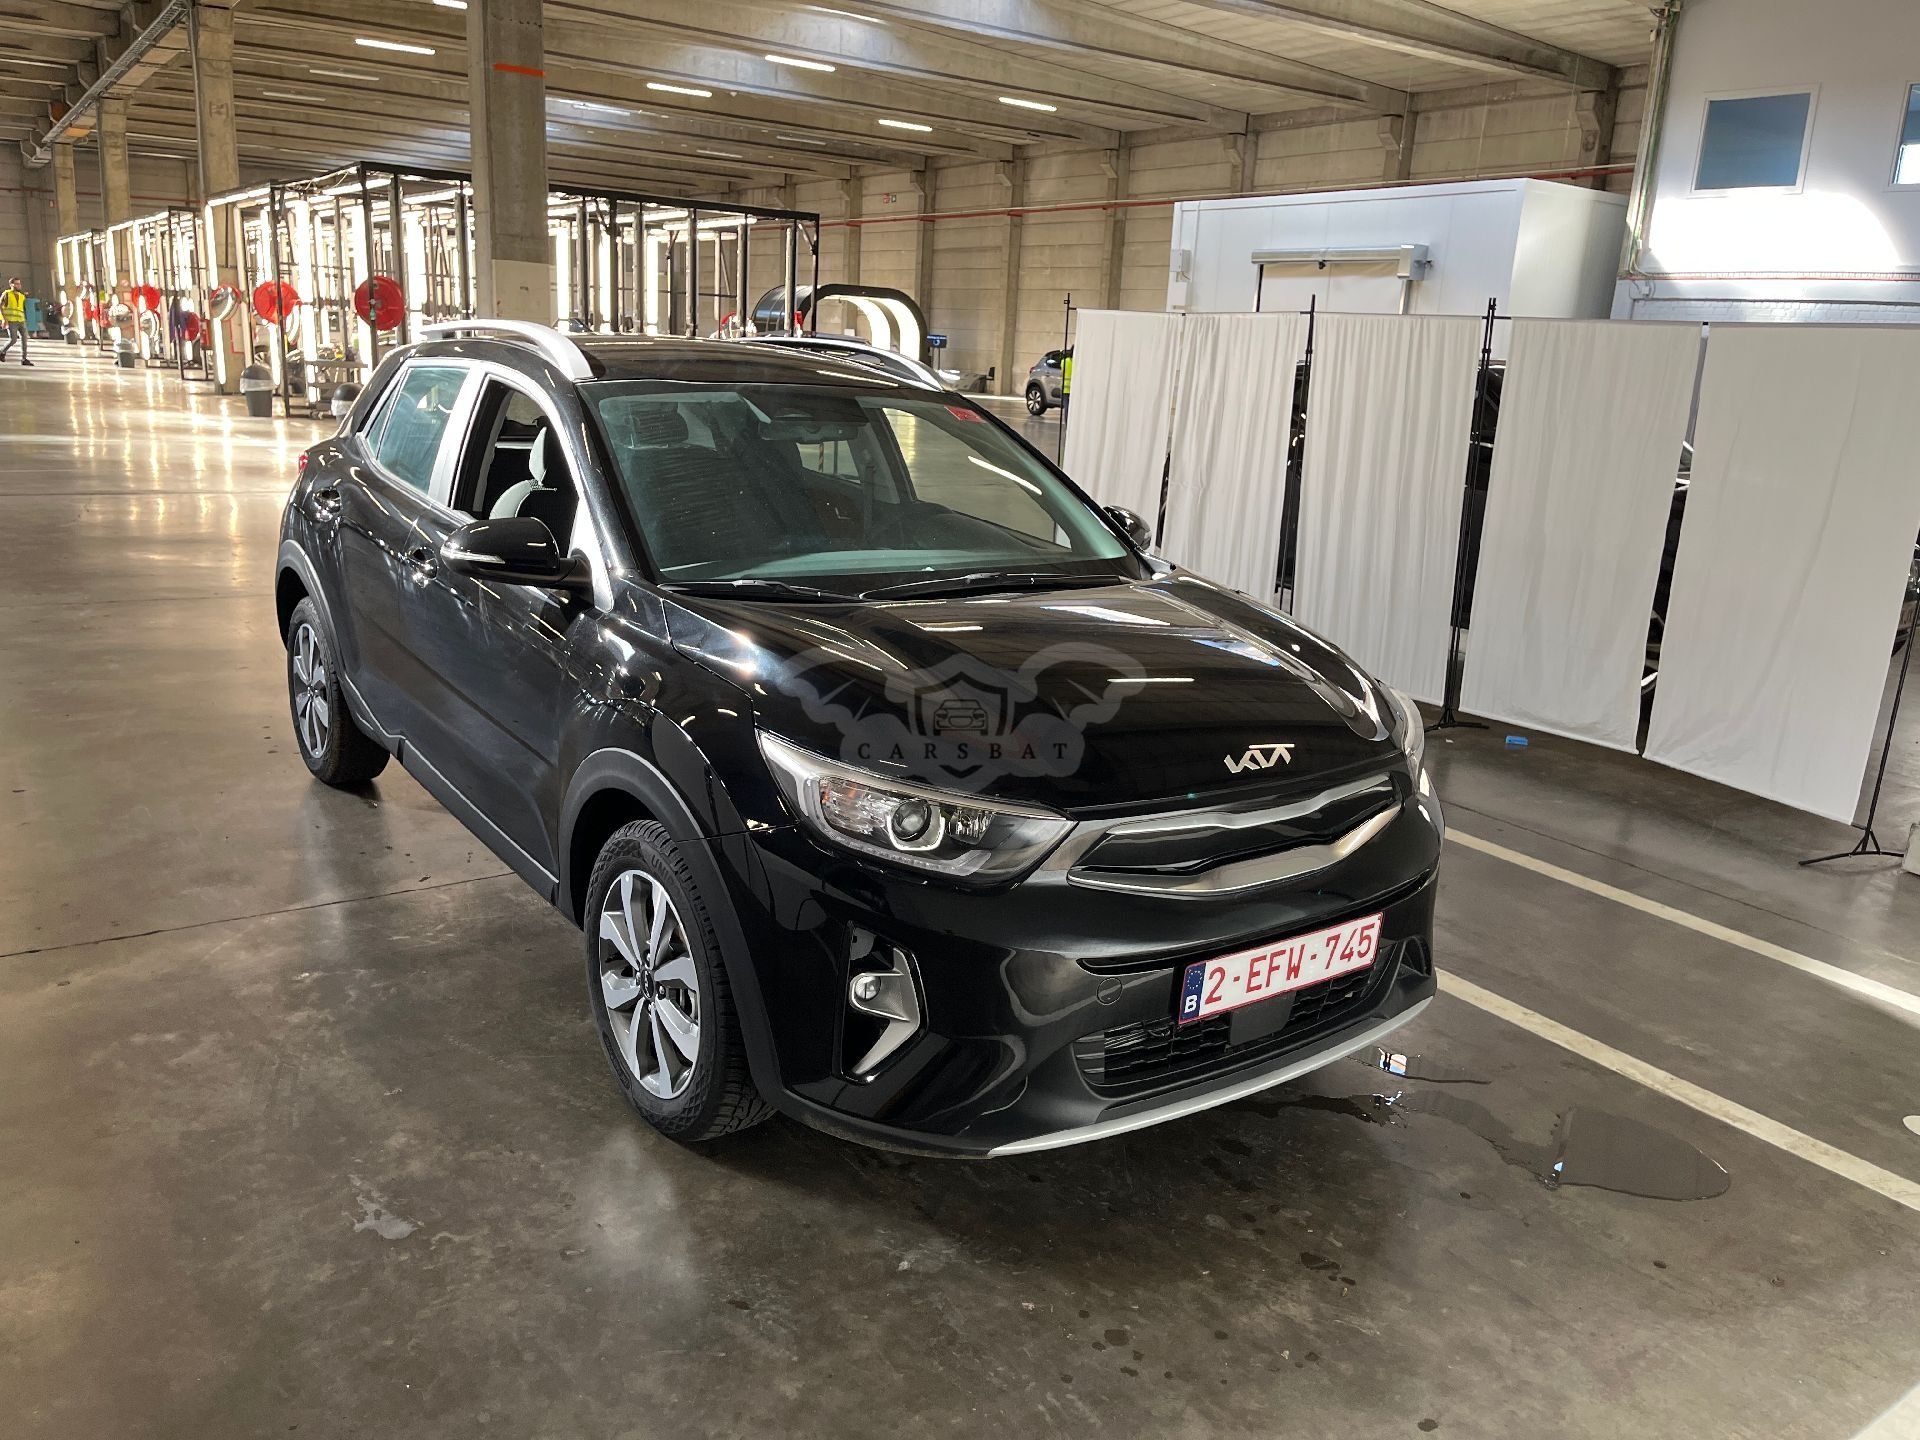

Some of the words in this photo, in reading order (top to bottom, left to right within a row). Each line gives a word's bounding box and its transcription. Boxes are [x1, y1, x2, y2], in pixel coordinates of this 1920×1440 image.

[1223, 743, 1295, 774] KIA
[1204, 922, 1375, 1005] 2-EFW-745
[1183, 994, 1198, 1014] B
